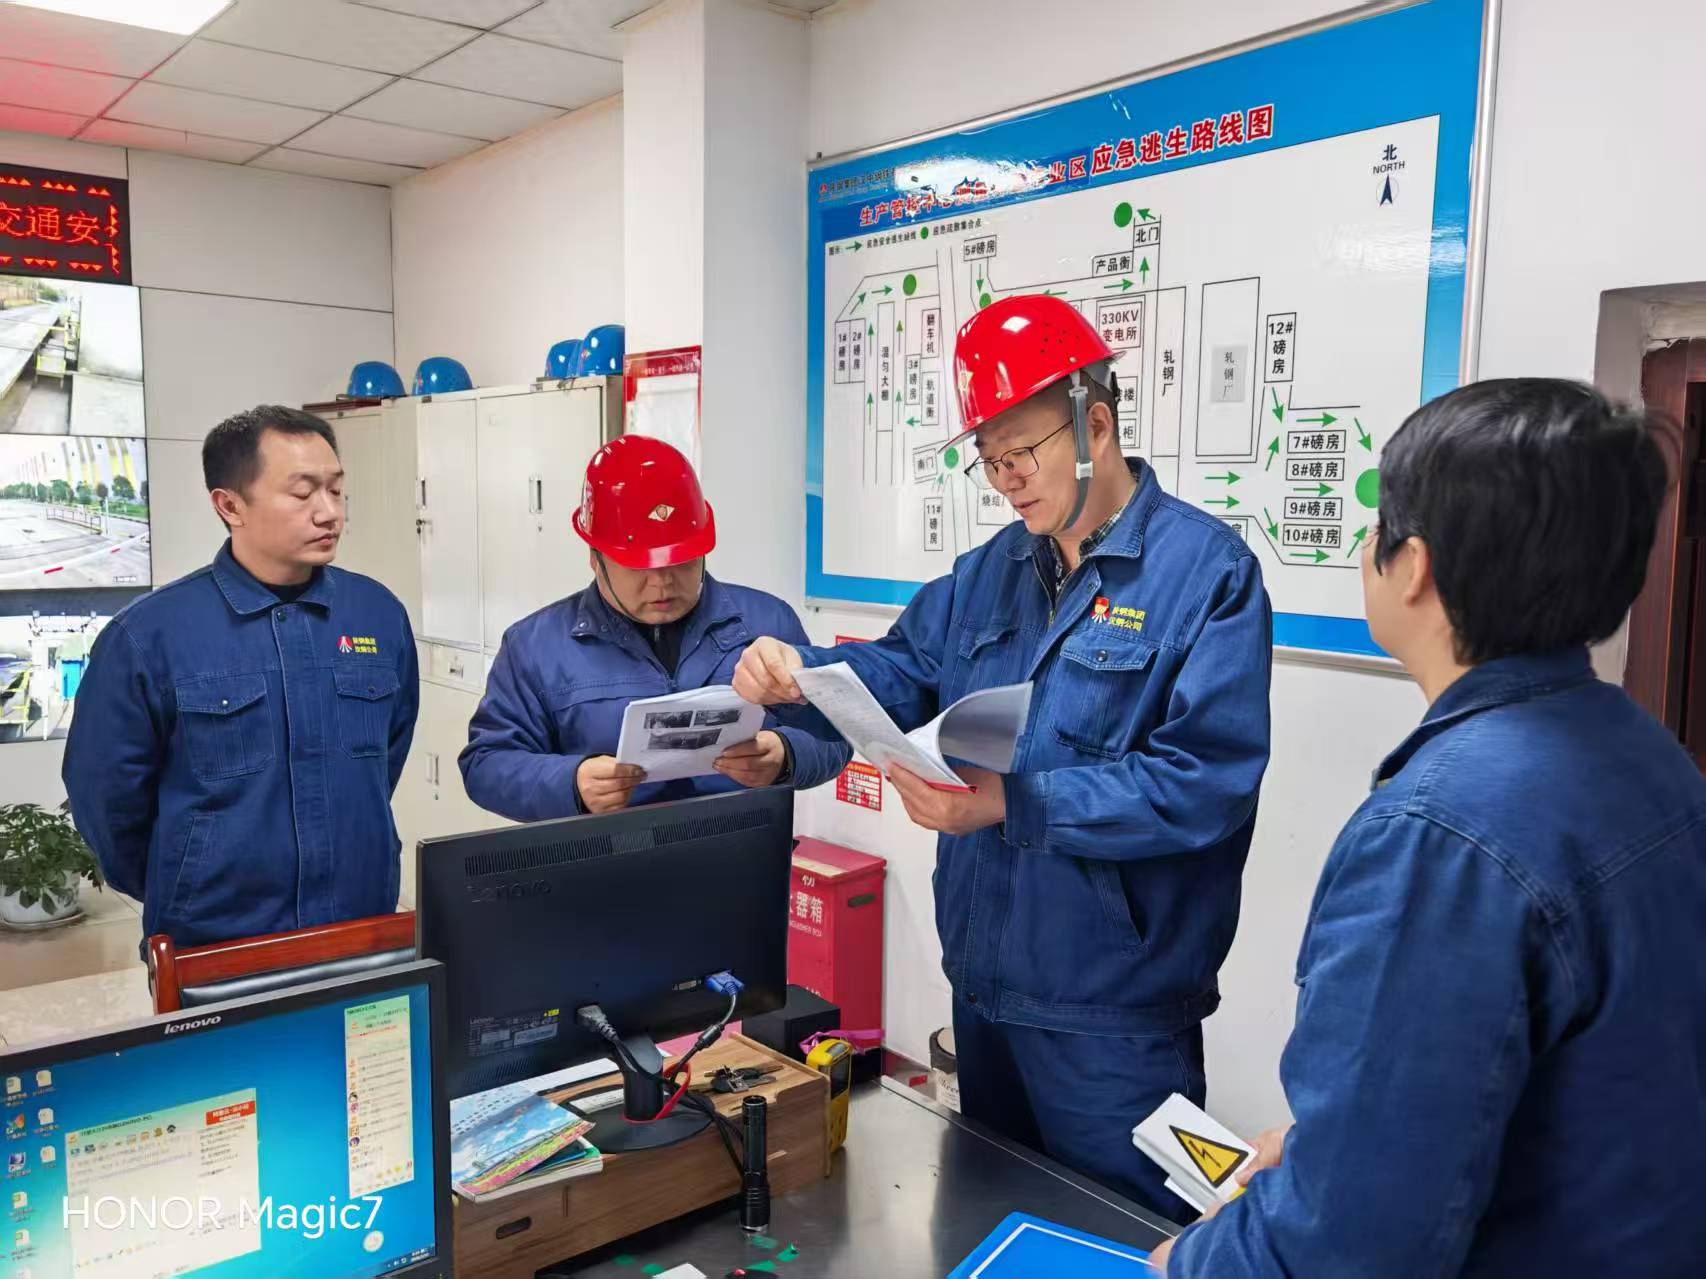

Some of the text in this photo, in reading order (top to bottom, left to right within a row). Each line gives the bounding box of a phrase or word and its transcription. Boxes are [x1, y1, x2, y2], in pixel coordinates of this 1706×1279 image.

[1382, 144, 1398, 161] 北
[1373, 160, 1405, 175] NORTH
[1135, 227, 1159, 243] 北门
[964, 239, 996, 256] 5#磅房
[1095, 255, 1131, 273] 产品衡
[1101, 309, 1139, 325] 330KV
[1102, 326, 1137, 342] 变电所
[1268, 321, 1294, 375] 12#磅房
[1162, 349, 1175, 397] 轧钢厂
[1223, 351, 1235, 399] 轧钢厂
[1293, 433, 1340, 450] 7#磅房
[1291, 461, 1339, 479] 8#磅房
[1289, 501, 1337, 518] 9#磅房
[1285, 528, 1339, 545] 10#磅房
[789, 891, 824, 924] 器箱
[164, 1014, 223, 1035] lenovo
